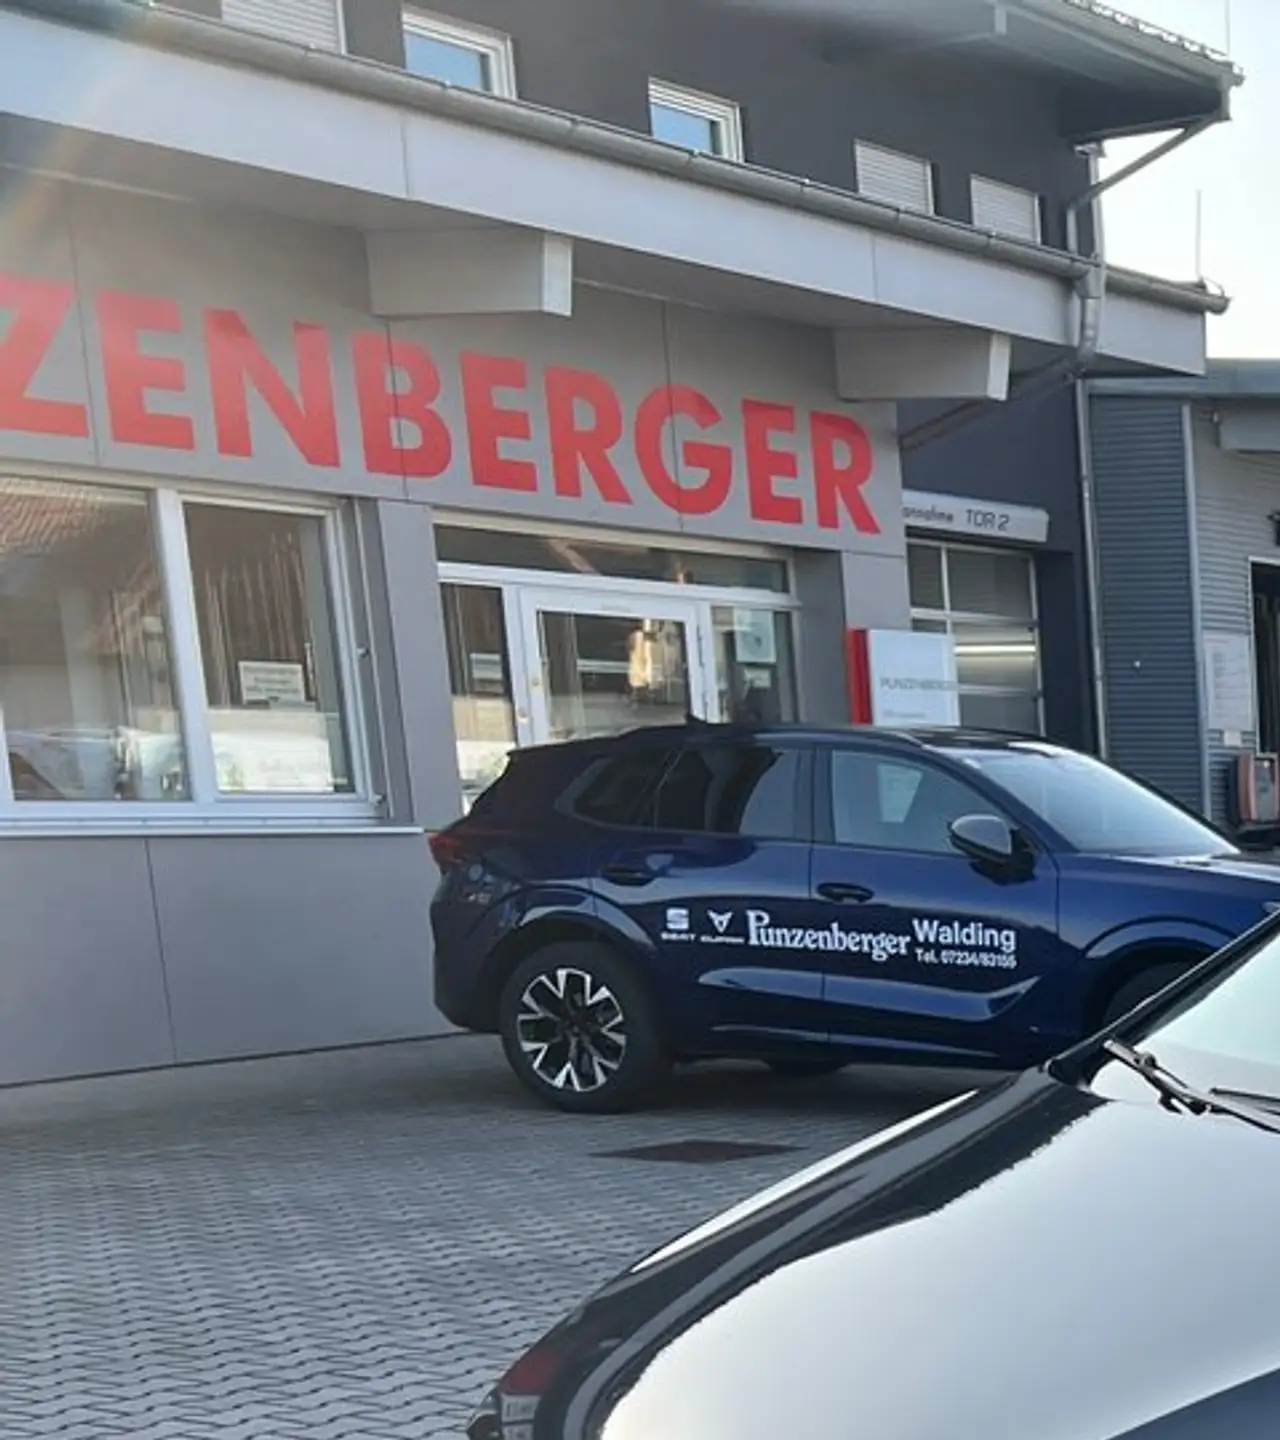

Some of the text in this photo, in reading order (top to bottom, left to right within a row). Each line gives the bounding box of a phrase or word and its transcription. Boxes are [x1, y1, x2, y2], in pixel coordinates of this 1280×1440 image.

[0, 272, 881, 535] ZENBERGER
[966, 508, 996, 529] TOR
[997, 514, 1010, 532] 2
[746, 909, 1015, 961] Punzenberger Walding
